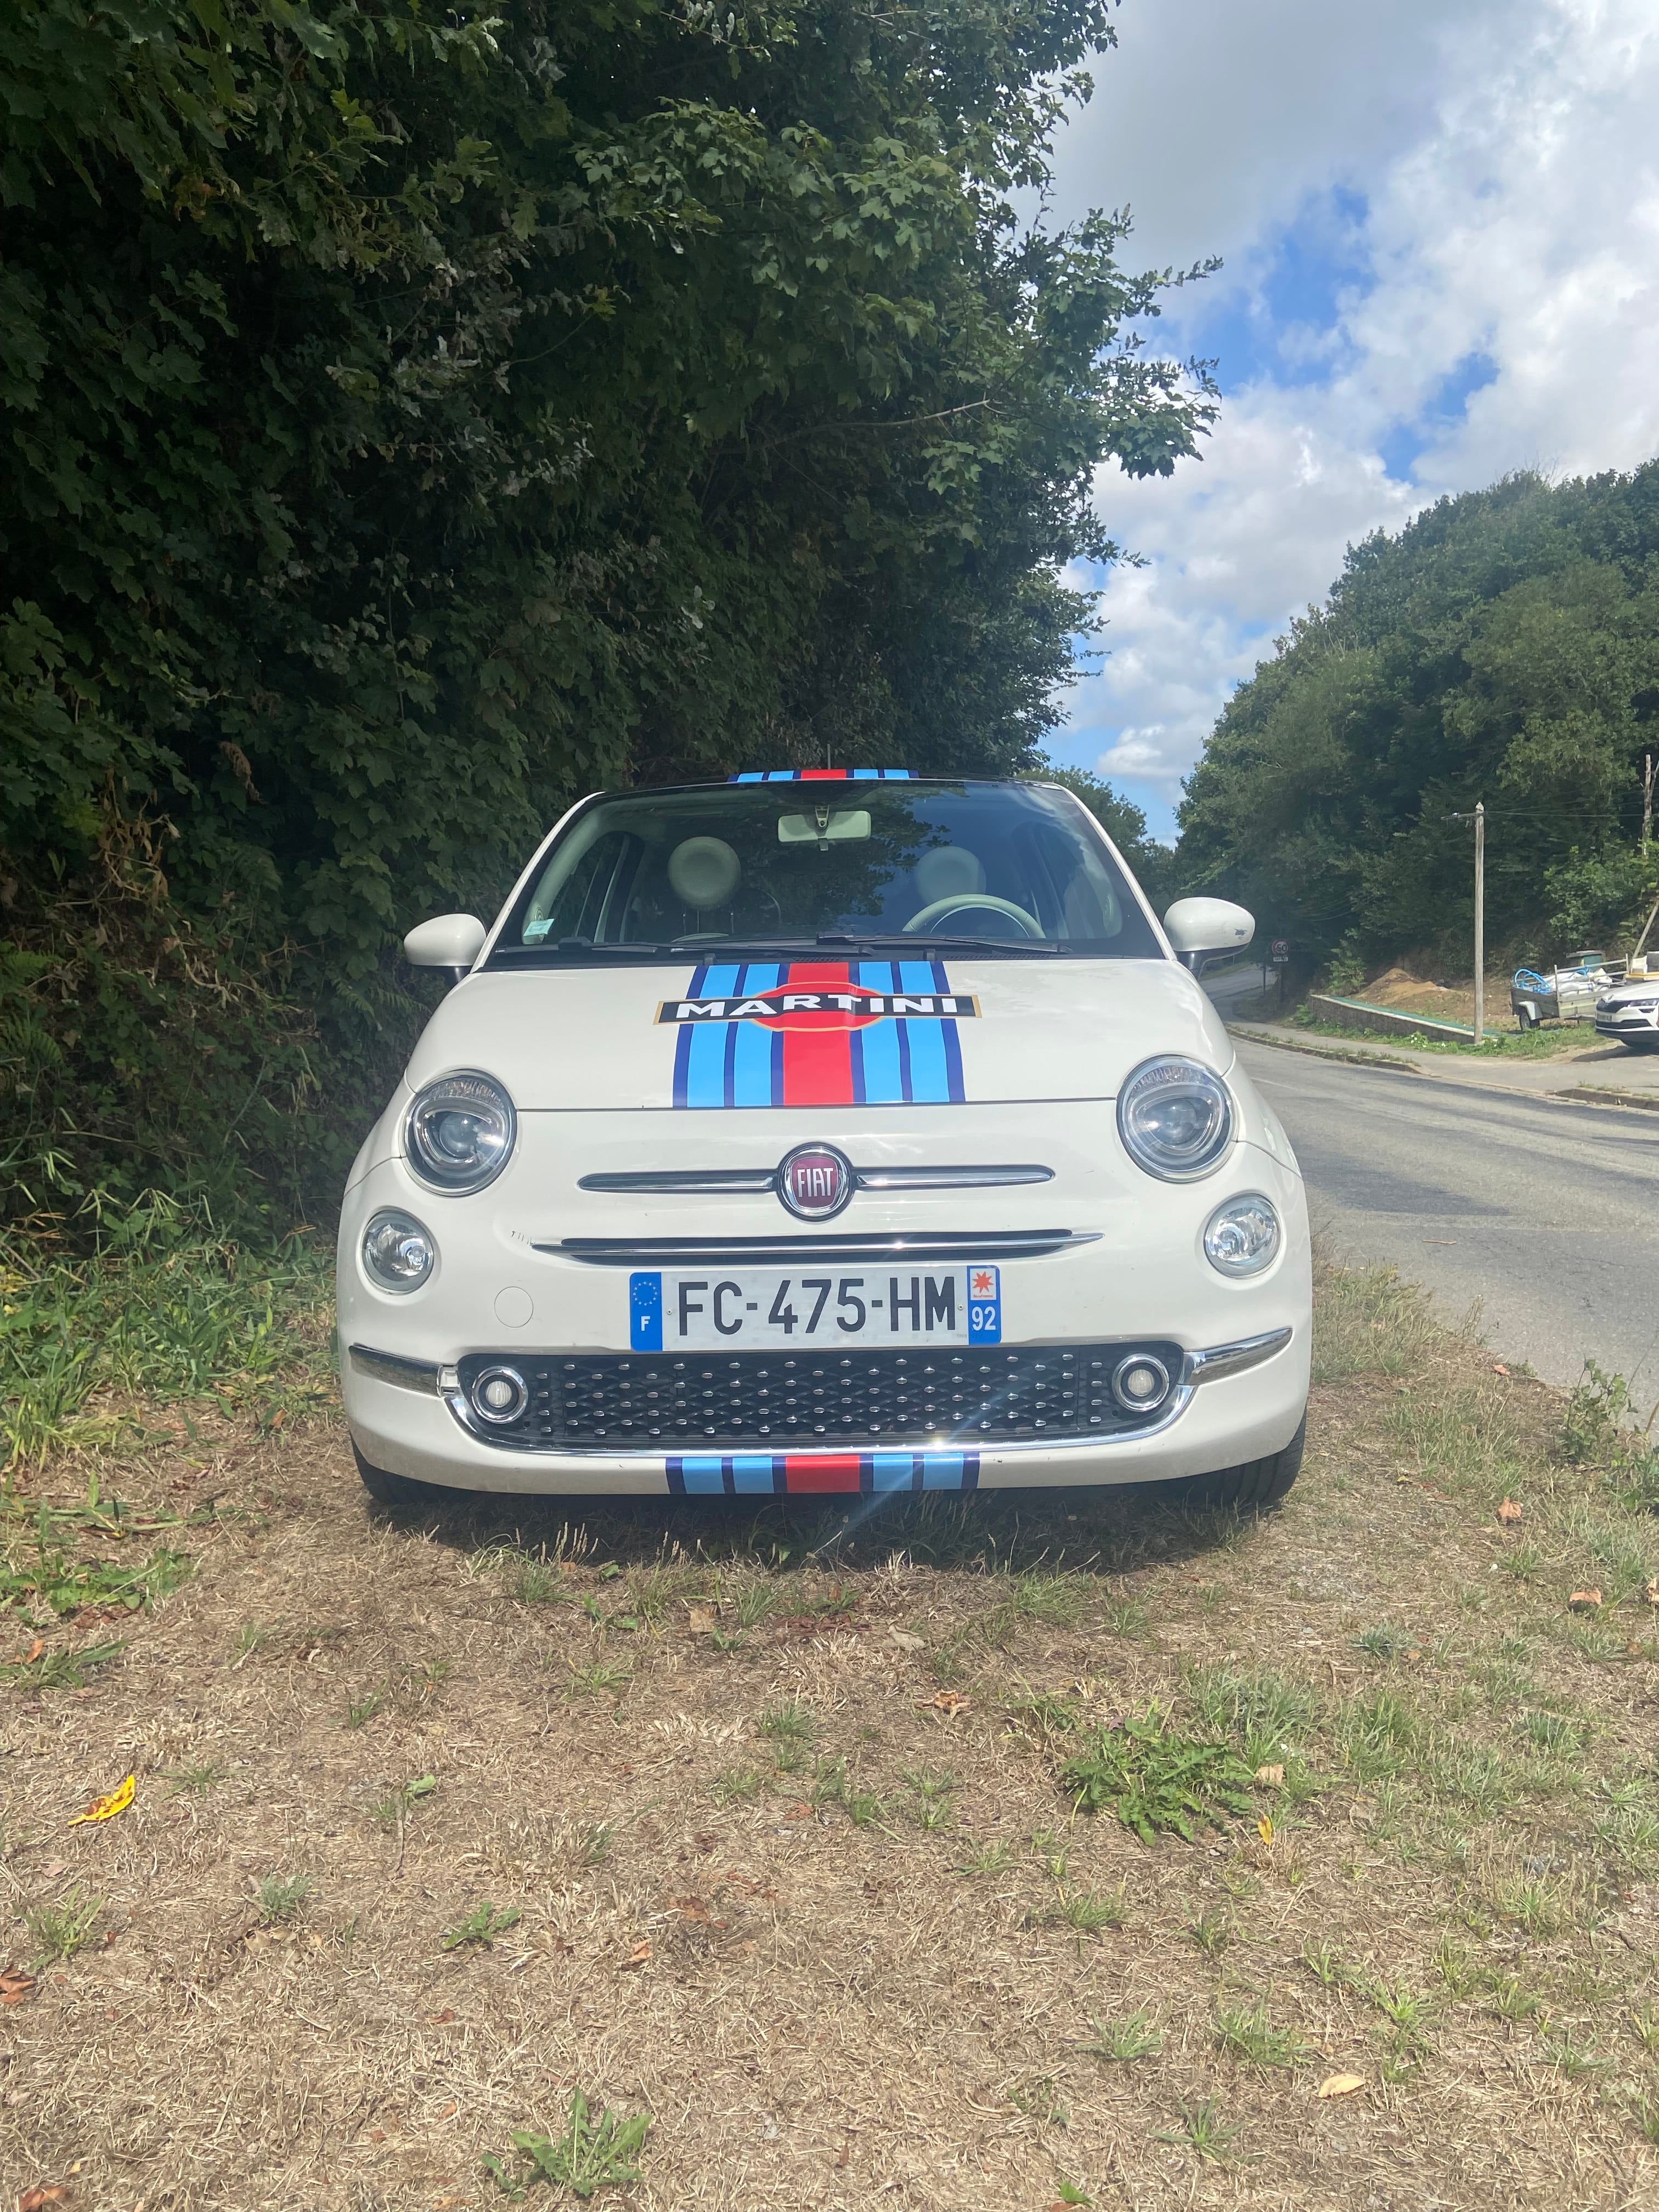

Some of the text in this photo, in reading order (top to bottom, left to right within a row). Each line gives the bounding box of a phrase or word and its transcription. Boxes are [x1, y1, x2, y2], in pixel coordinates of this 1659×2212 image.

[676, 994, 957, 1018] MARTINI
[797, 1167, 833, 1198] FIAT
[678, 1277, 956, 1336] FC-475-HM
[972, 1306, 996, 1331] 92
[641, 1316, 651, 1331] F
